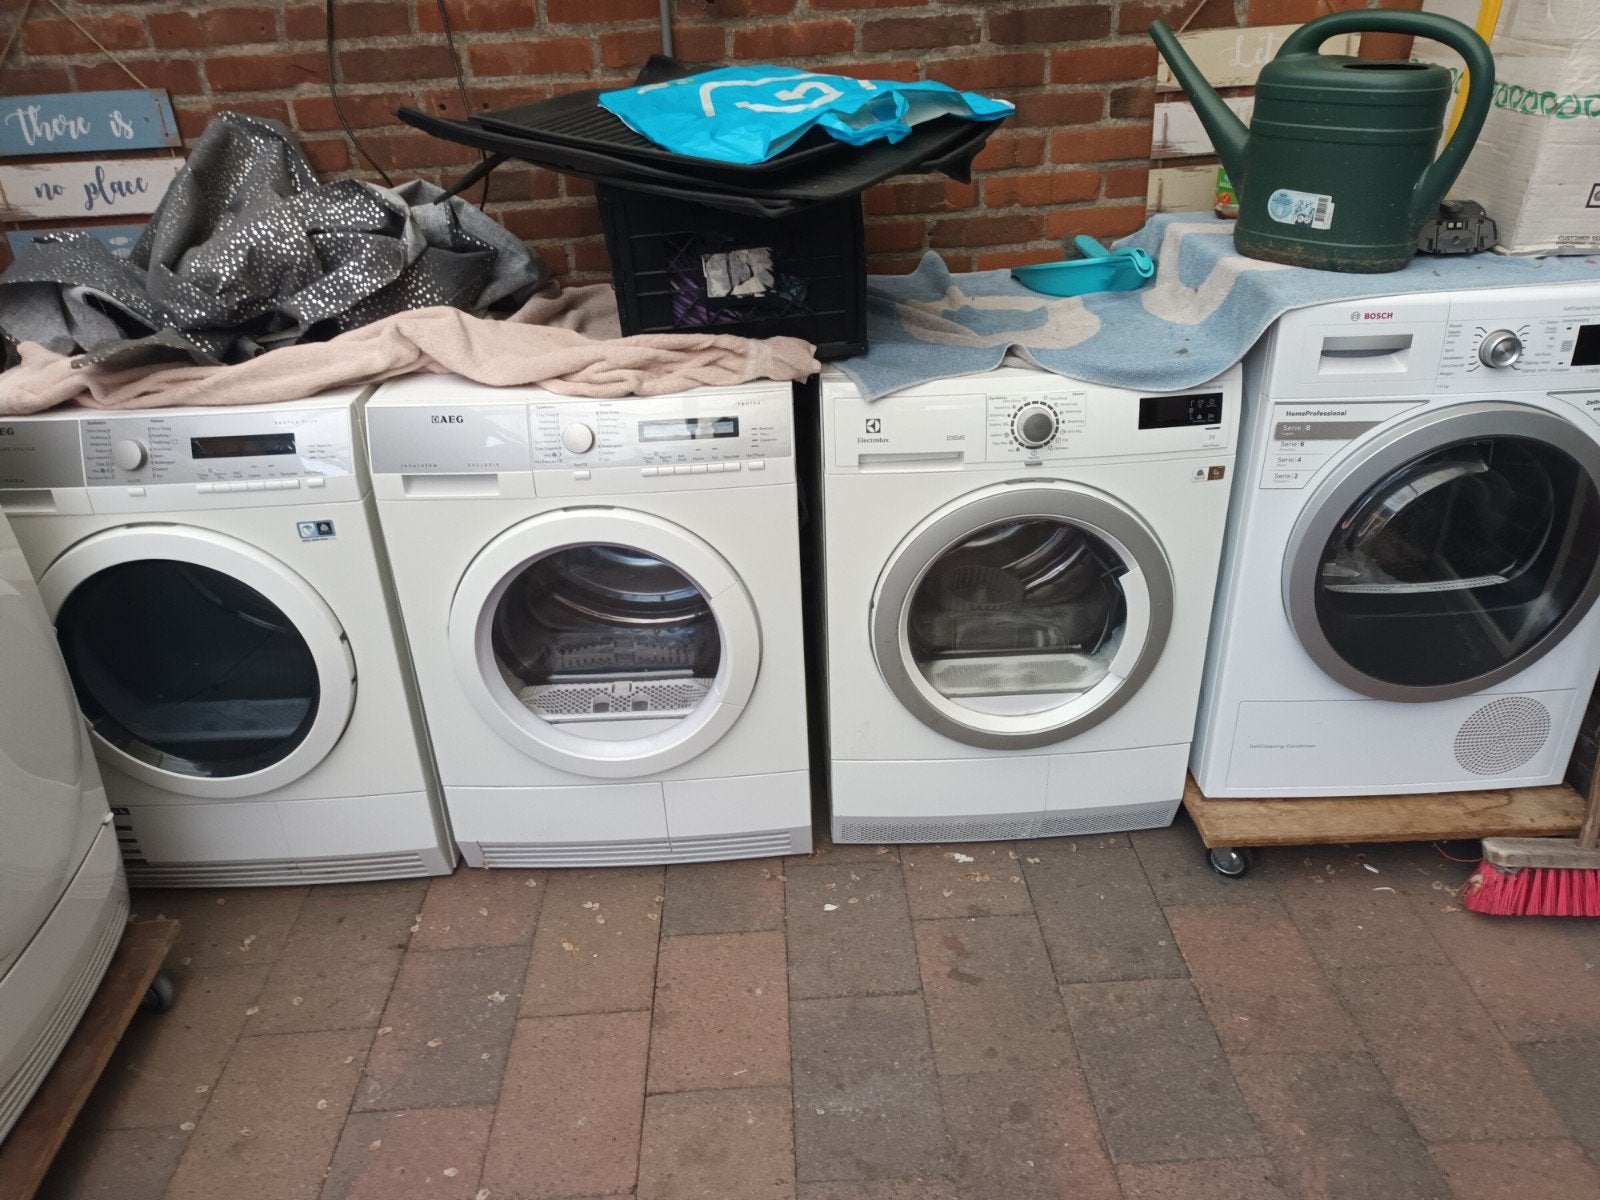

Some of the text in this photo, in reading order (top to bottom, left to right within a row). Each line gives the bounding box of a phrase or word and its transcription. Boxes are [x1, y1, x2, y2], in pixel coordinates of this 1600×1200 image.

[5, 105, 135, 147] there is
[34, 165, 149, 211] no place
[1363, 312, 1394, 320] BOSCH
[440, 415, 464, 424] AEG
